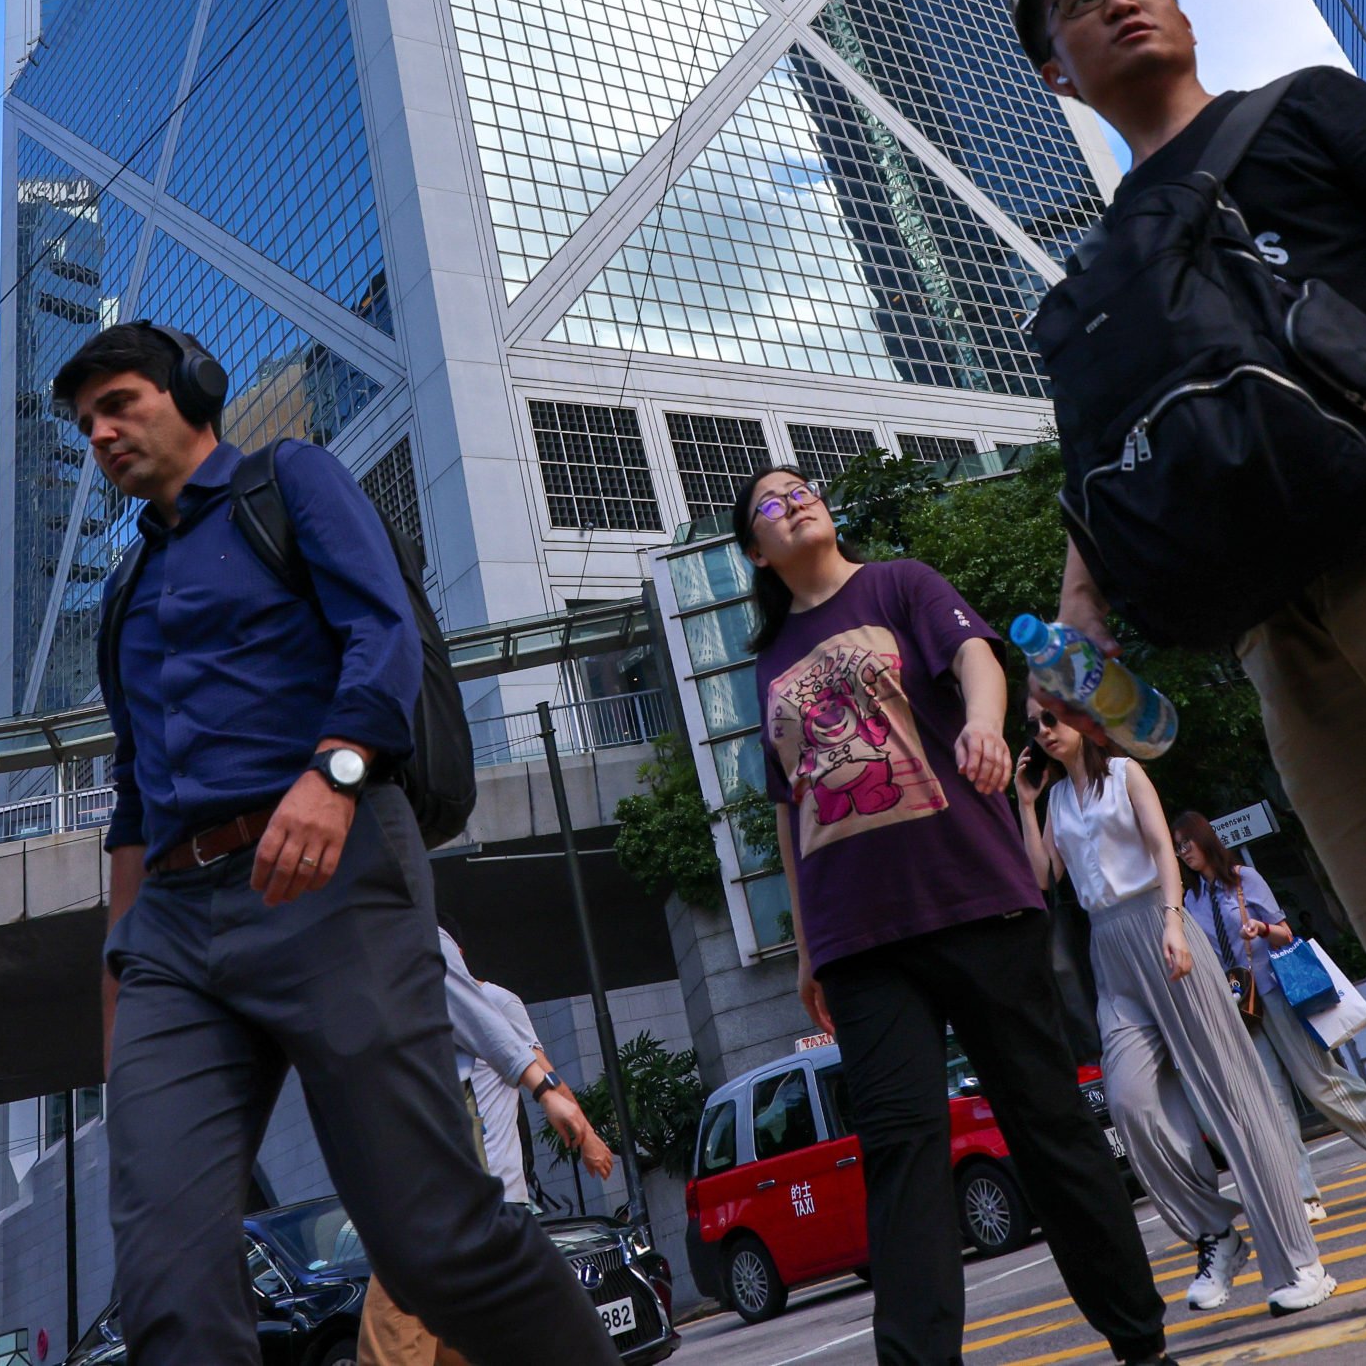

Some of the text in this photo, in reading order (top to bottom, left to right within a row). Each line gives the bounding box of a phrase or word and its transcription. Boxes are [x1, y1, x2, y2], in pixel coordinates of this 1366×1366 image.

[802, 1034, 832, 1049] TAXI
[791, 1181, 811, 1200] 的士
[792, 1197, 815, 1217] TAXI
